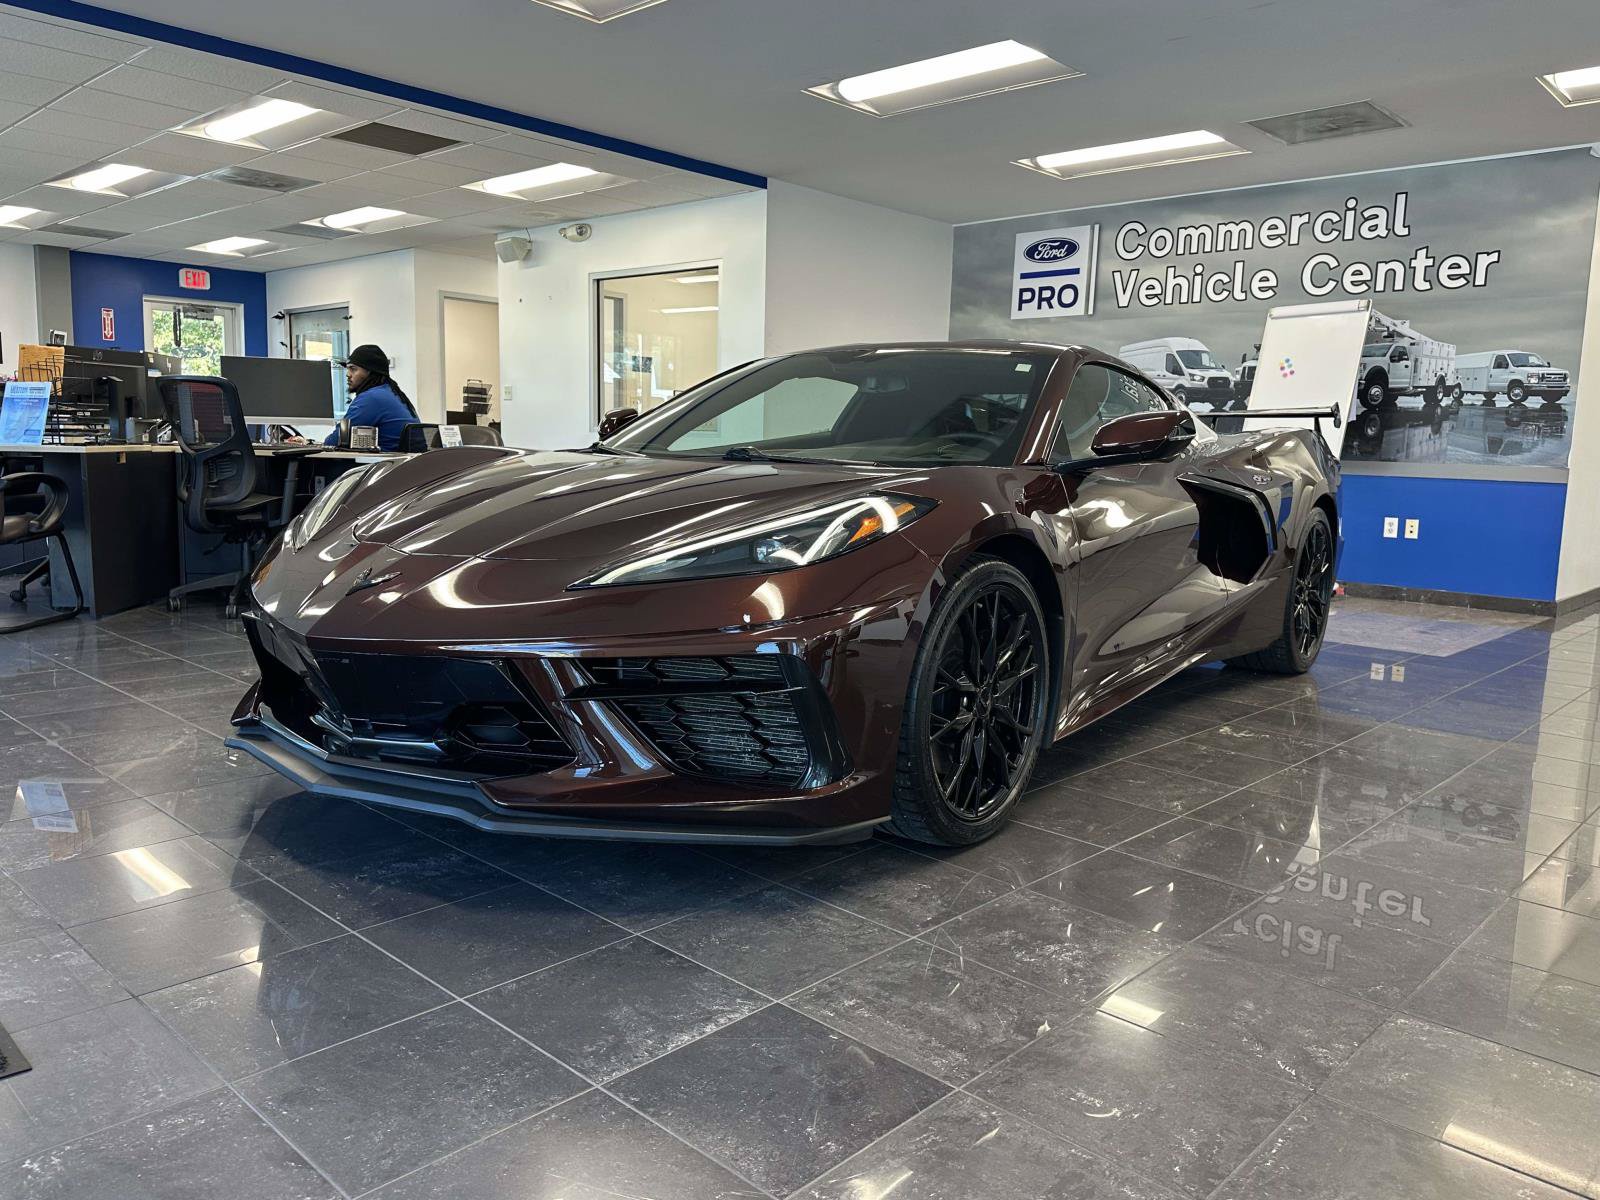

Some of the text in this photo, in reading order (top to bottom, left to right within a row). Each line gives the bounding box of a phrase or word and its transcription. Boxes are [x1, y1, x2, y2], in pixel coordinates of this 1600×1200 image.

[1115, 192, 1410, 261] Commercial
[1034, 241, 1069, 260] Ford
[185, 270, 207, 288] EXIT
[1112, 246, 1501, 308] Vehicle Center
[1017, 283, 1079, 311] PRO
